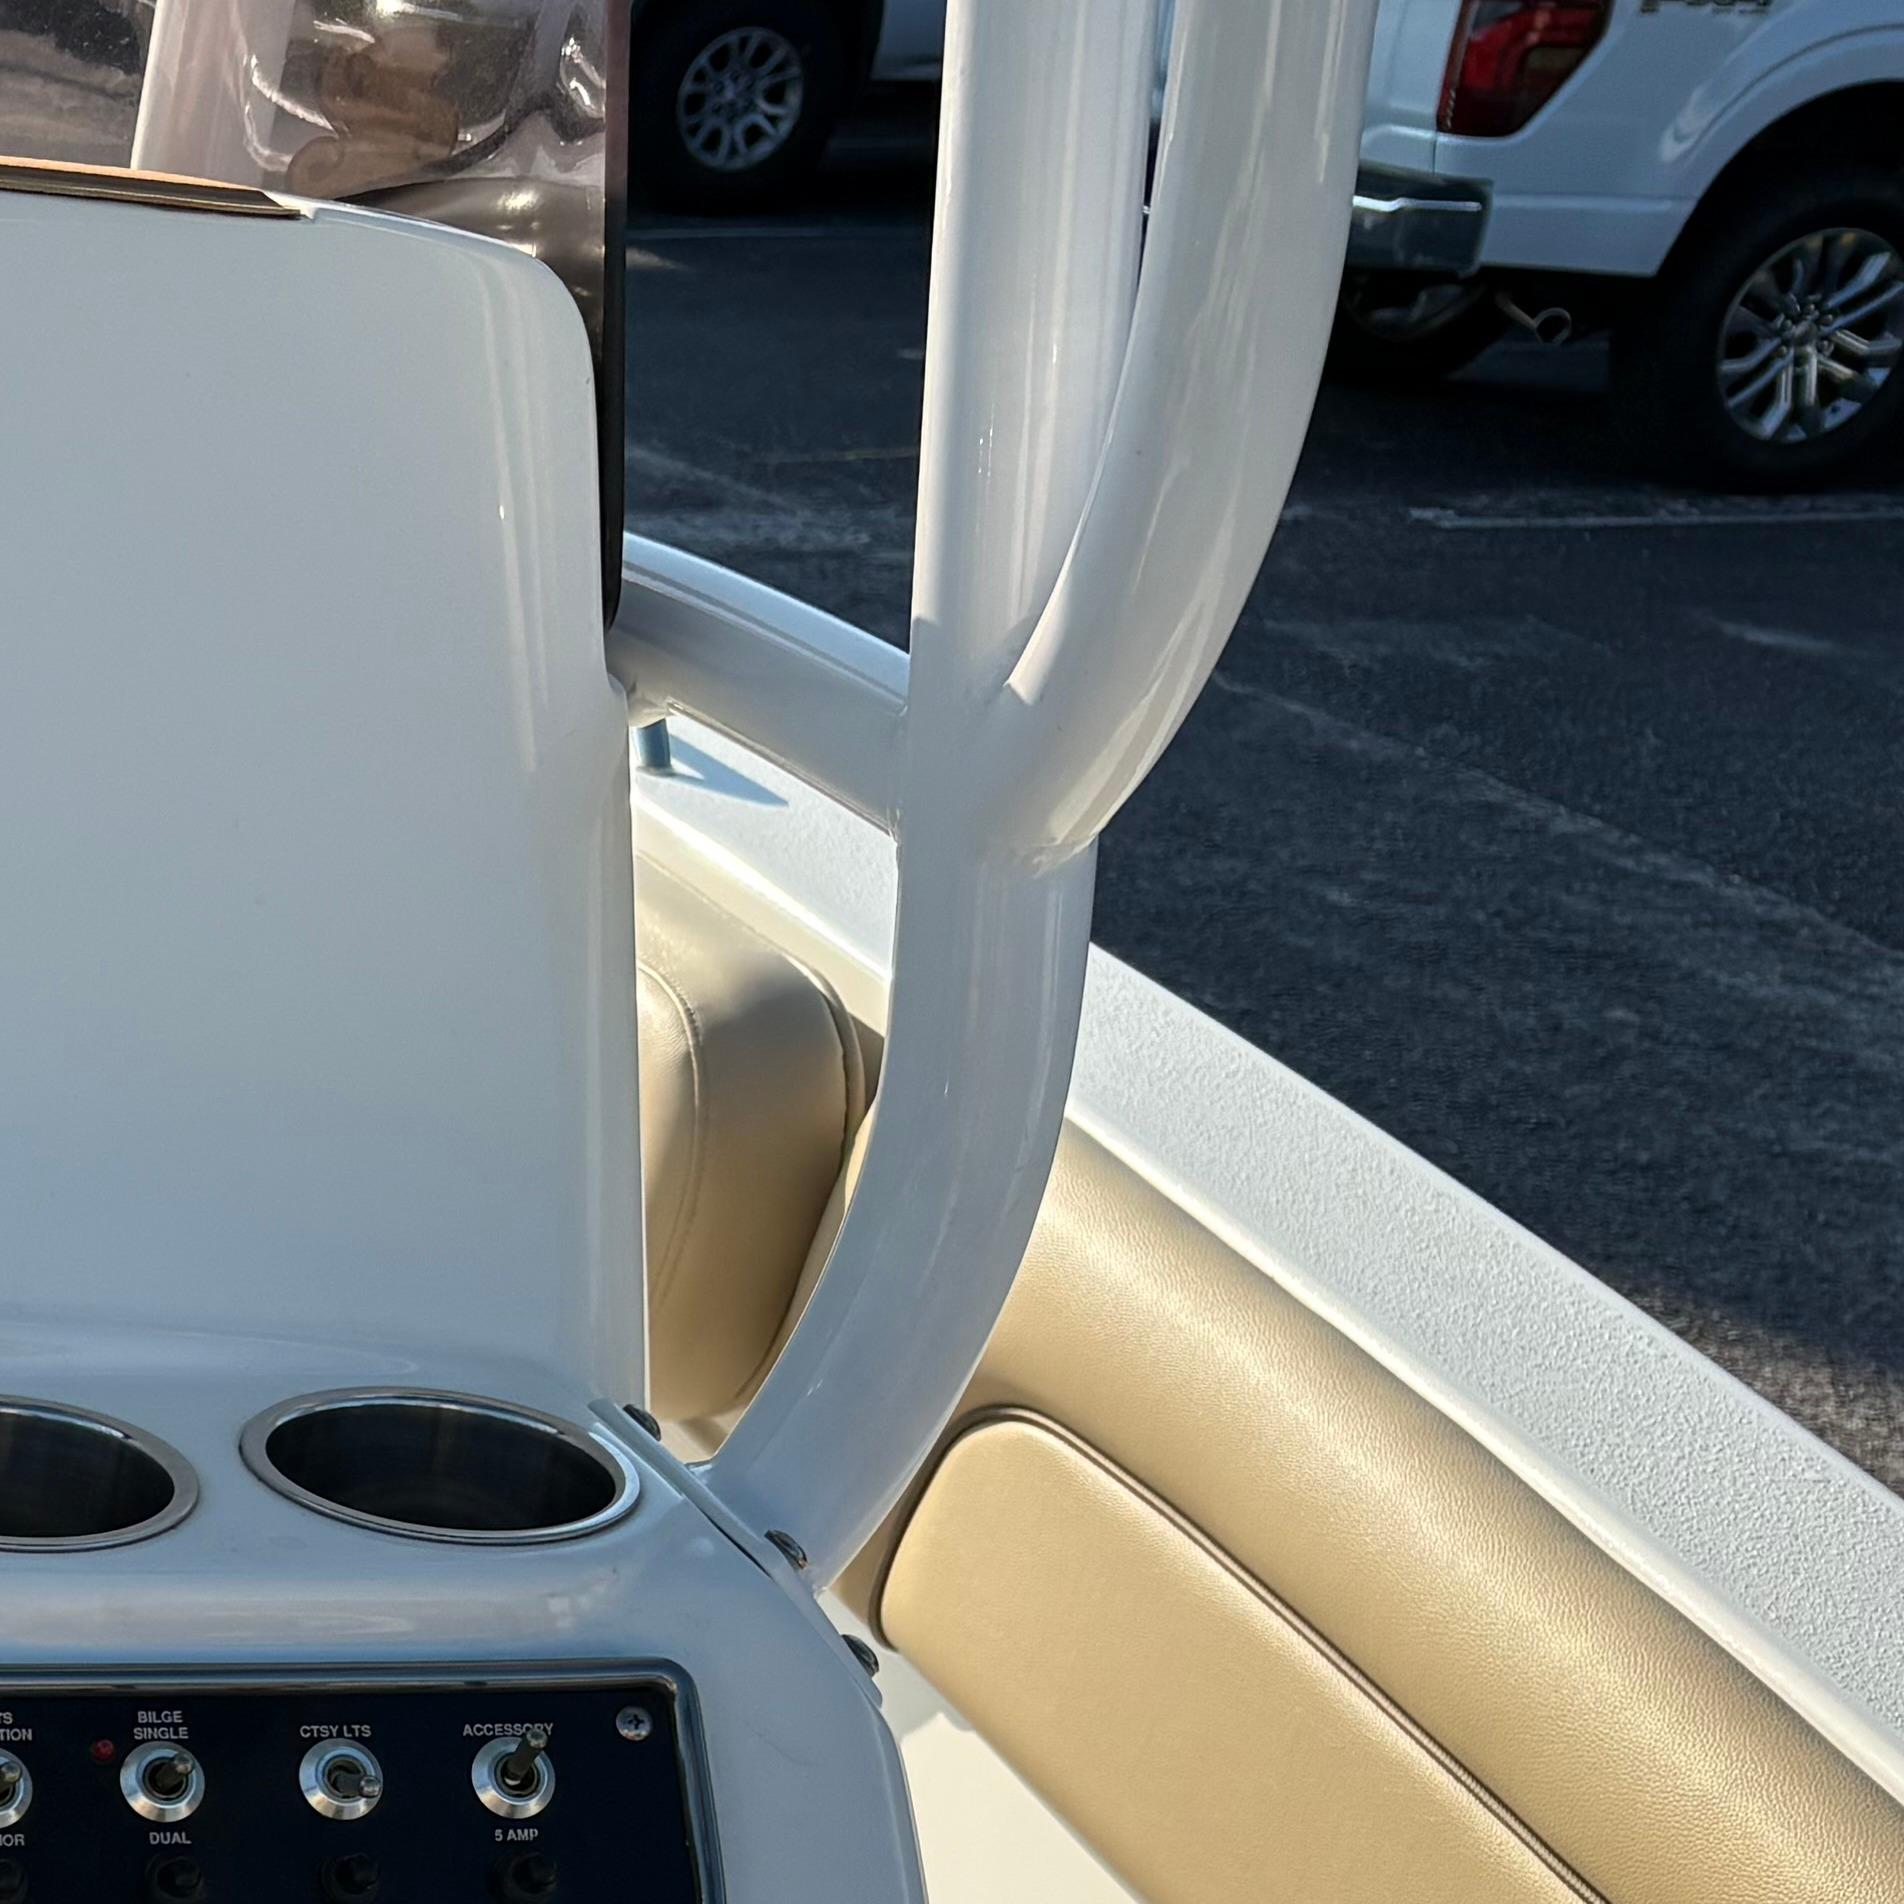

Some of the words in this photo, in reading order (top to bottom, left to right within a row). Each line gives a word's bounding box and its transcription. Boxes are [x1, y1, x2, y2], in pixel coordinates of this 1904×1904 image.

[138, 1710, 183, 1723] BILGE
[134, 1728, 189, 1740] SINGLE
[300, 1725, 339, 1738] CTSY
[343, 1725, 372, 1738] LTS
[150, 1832, 192, 1845] DUAL
[495, 1829, 503, 1841] 5
[507, 1829, 538, 1841] AMP
